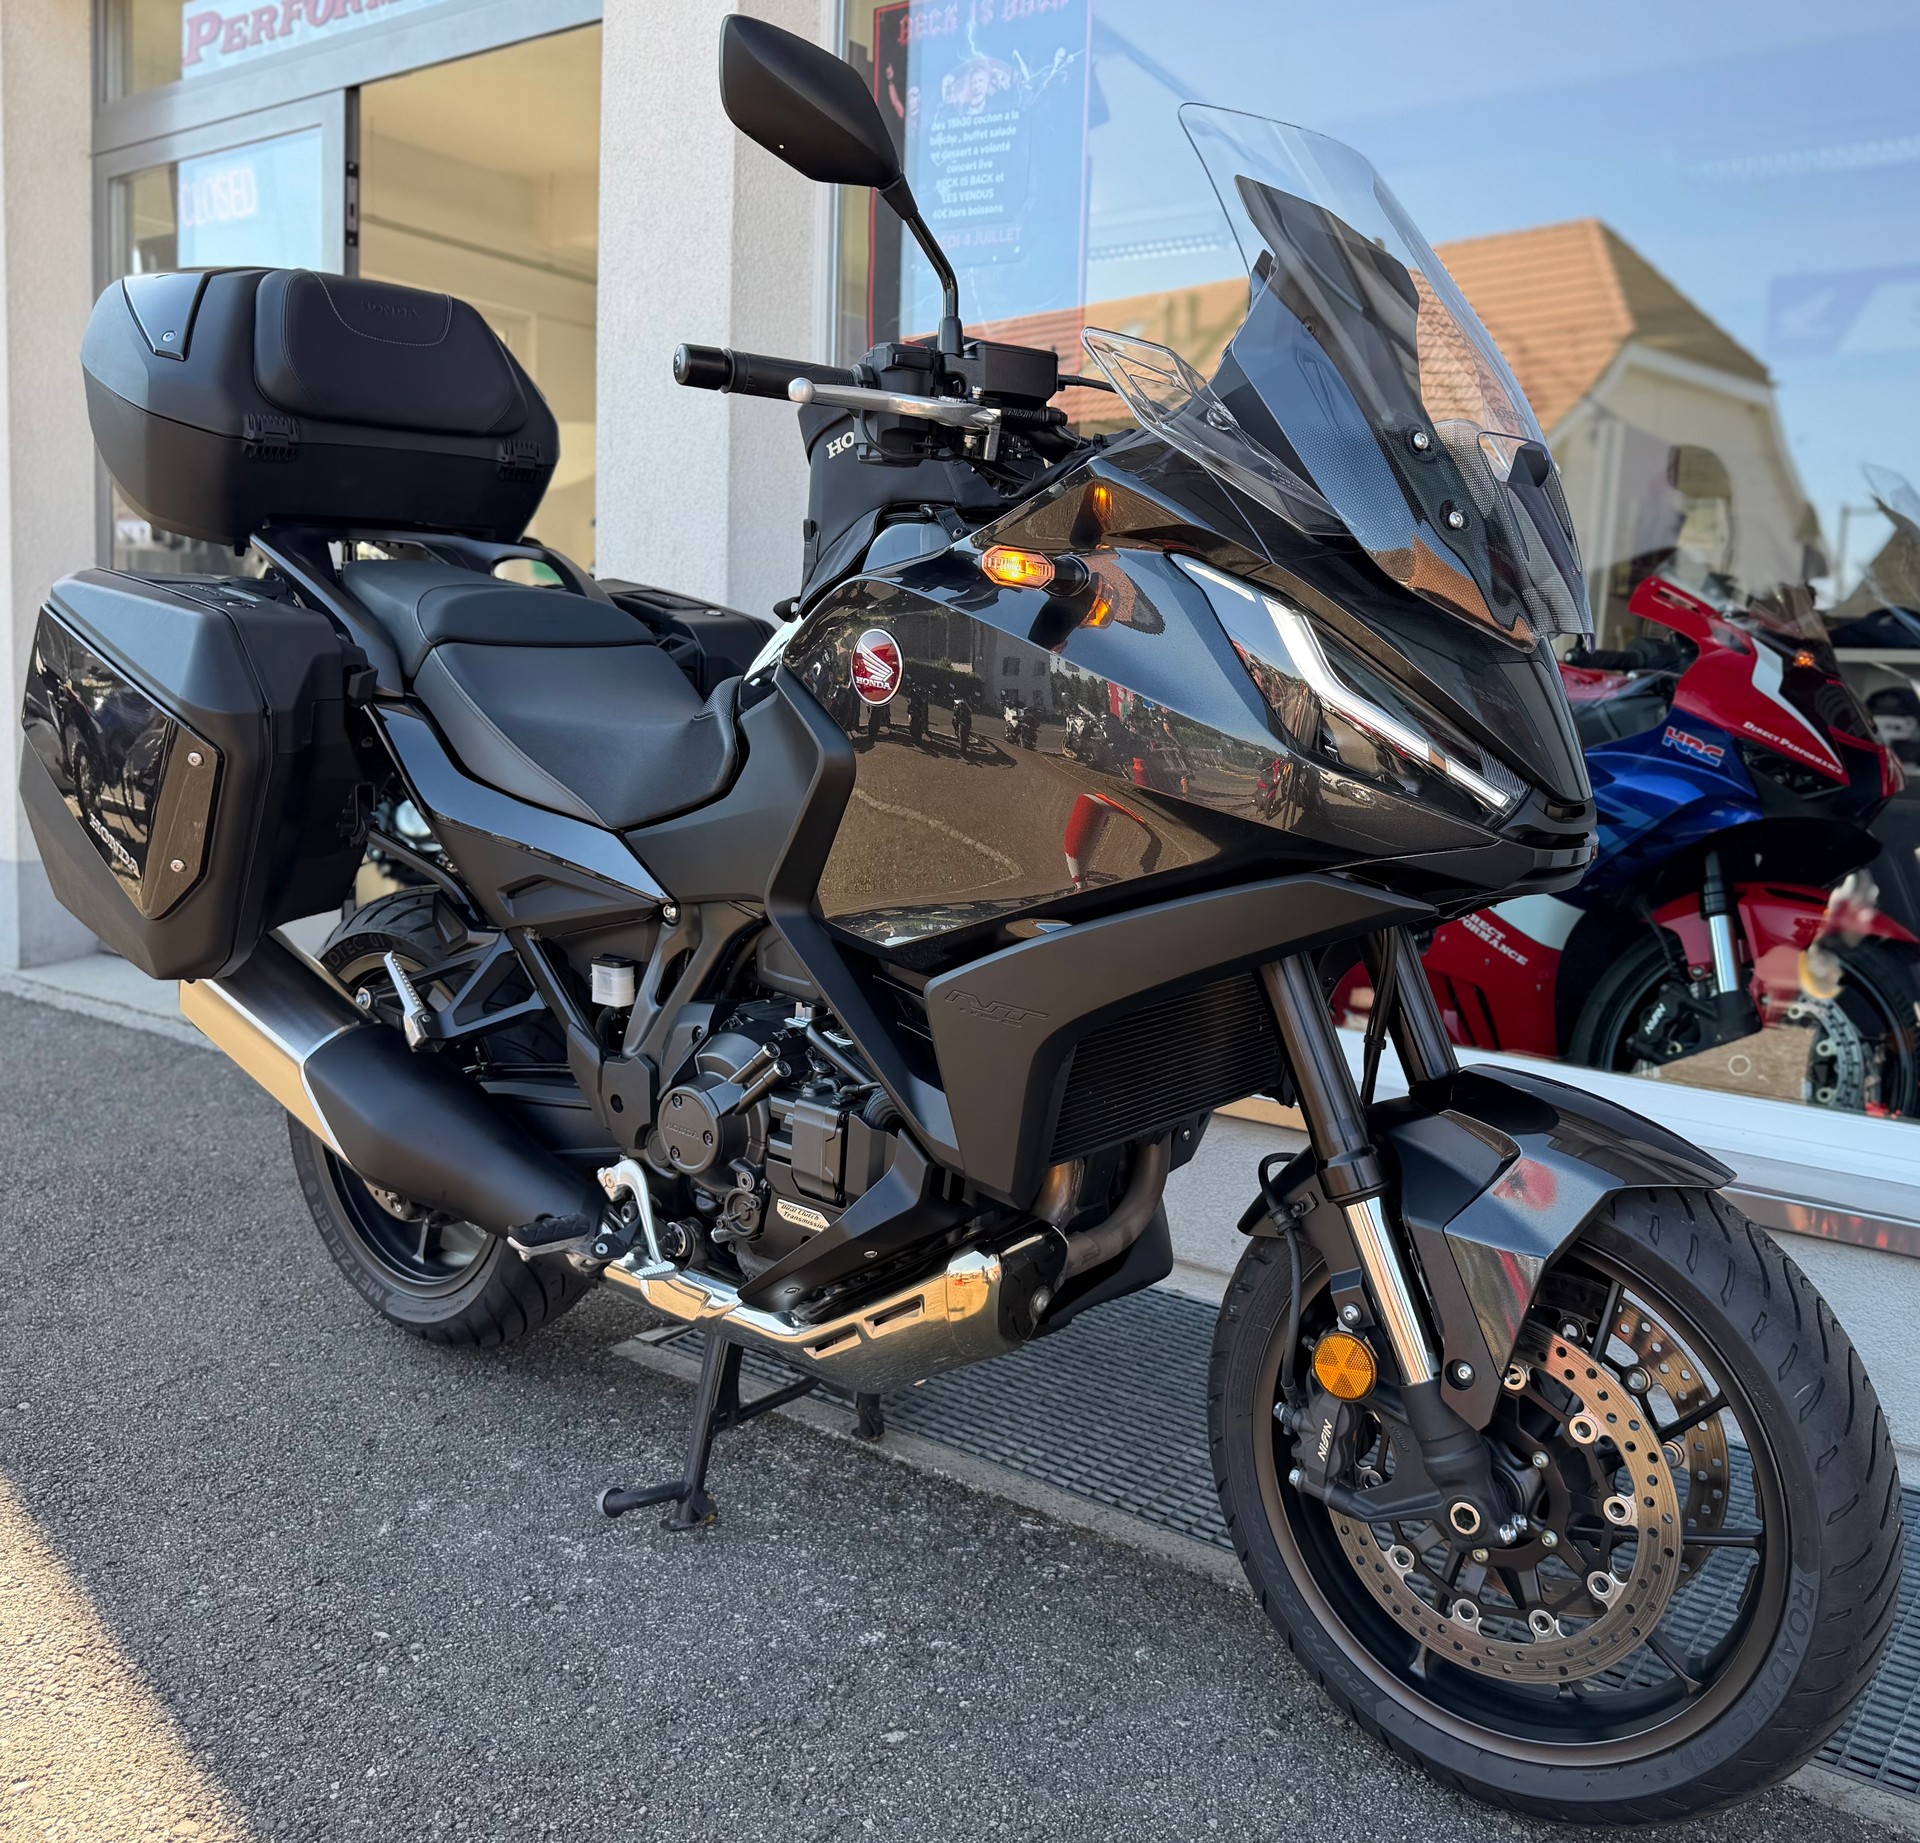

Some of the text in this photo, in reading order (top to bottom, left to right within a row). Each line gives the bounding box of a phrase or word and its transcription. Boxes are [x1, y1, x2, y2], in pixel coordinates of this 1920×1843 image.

[181, 0, 404, 68] PERFO
[973, 112, 1004, 126] cochon
[1011, 108, 1019, 120] la
[963, 128, 988, 142] buffet
[989, 123, 1017, 138] salade
[946, 159, 993, 174] concert live
[960, 175, 969, 186] IS
[970, 173, 994, 186] BACK
[995, 172, 1005, 183] et
[179, 167, 256, 227] CLOSED
[959, 187, 994, 202] VENDUS
[948, 206, 967, 218] hors
[967, 203, 1004, 216] boissons
[963, 232, 971, 246] 4
[972, 226, 1022, 247] JUILLET
[855, 676, 893, 691] HONDA
[1662, 725, 1725, 768] HRC
[1743, 721, 1843, 775] DIRECT PERFORMANCE
[89, 812, 141, 879] HONDA
[1465, 912, 1507, 941] RECT
[1457, 916, 1529, 966] ORMANCE
[781, 1203, 820, 1221] Dual Clutch
[312, 1202, 385, 1303] METZELER
